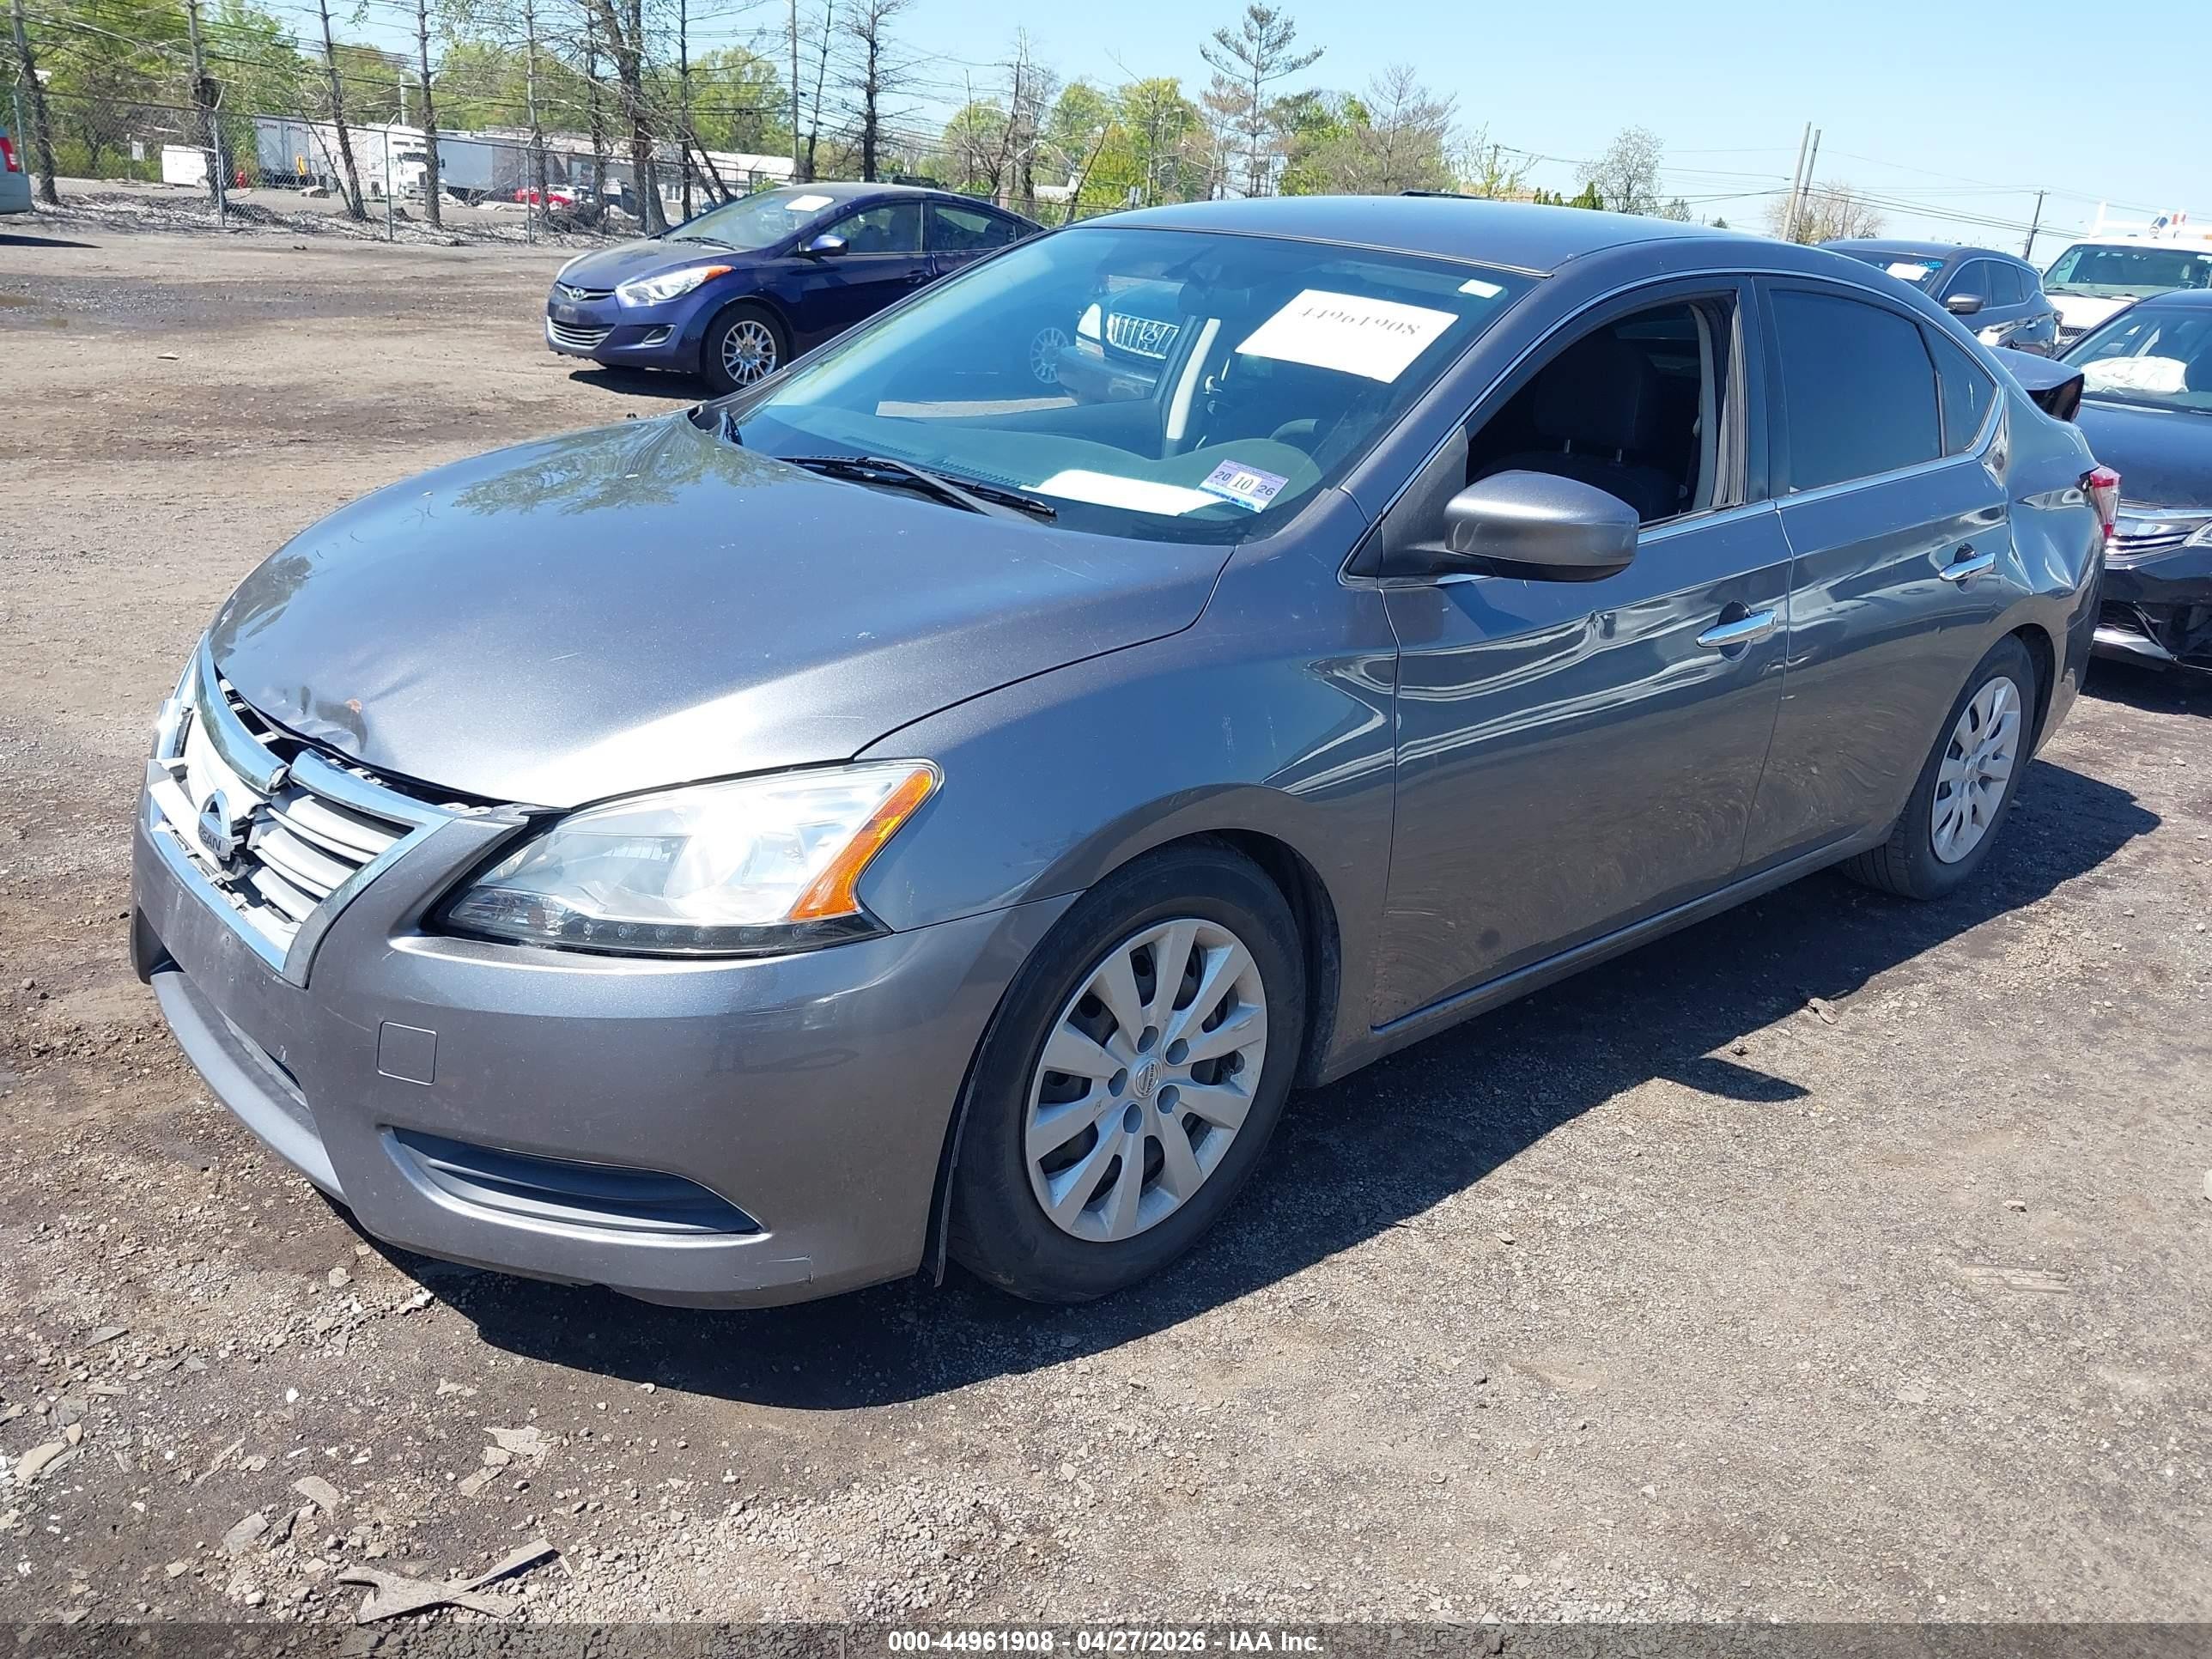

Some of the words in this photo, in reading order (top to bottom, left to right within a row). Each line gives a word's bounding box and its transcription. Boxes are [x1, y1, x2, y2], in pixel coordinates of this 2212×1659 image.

[1214, 471, 1231, 482] 20
[1231, 477, 1254, 490] 10
[1257, 484, 1276, 496] 26
